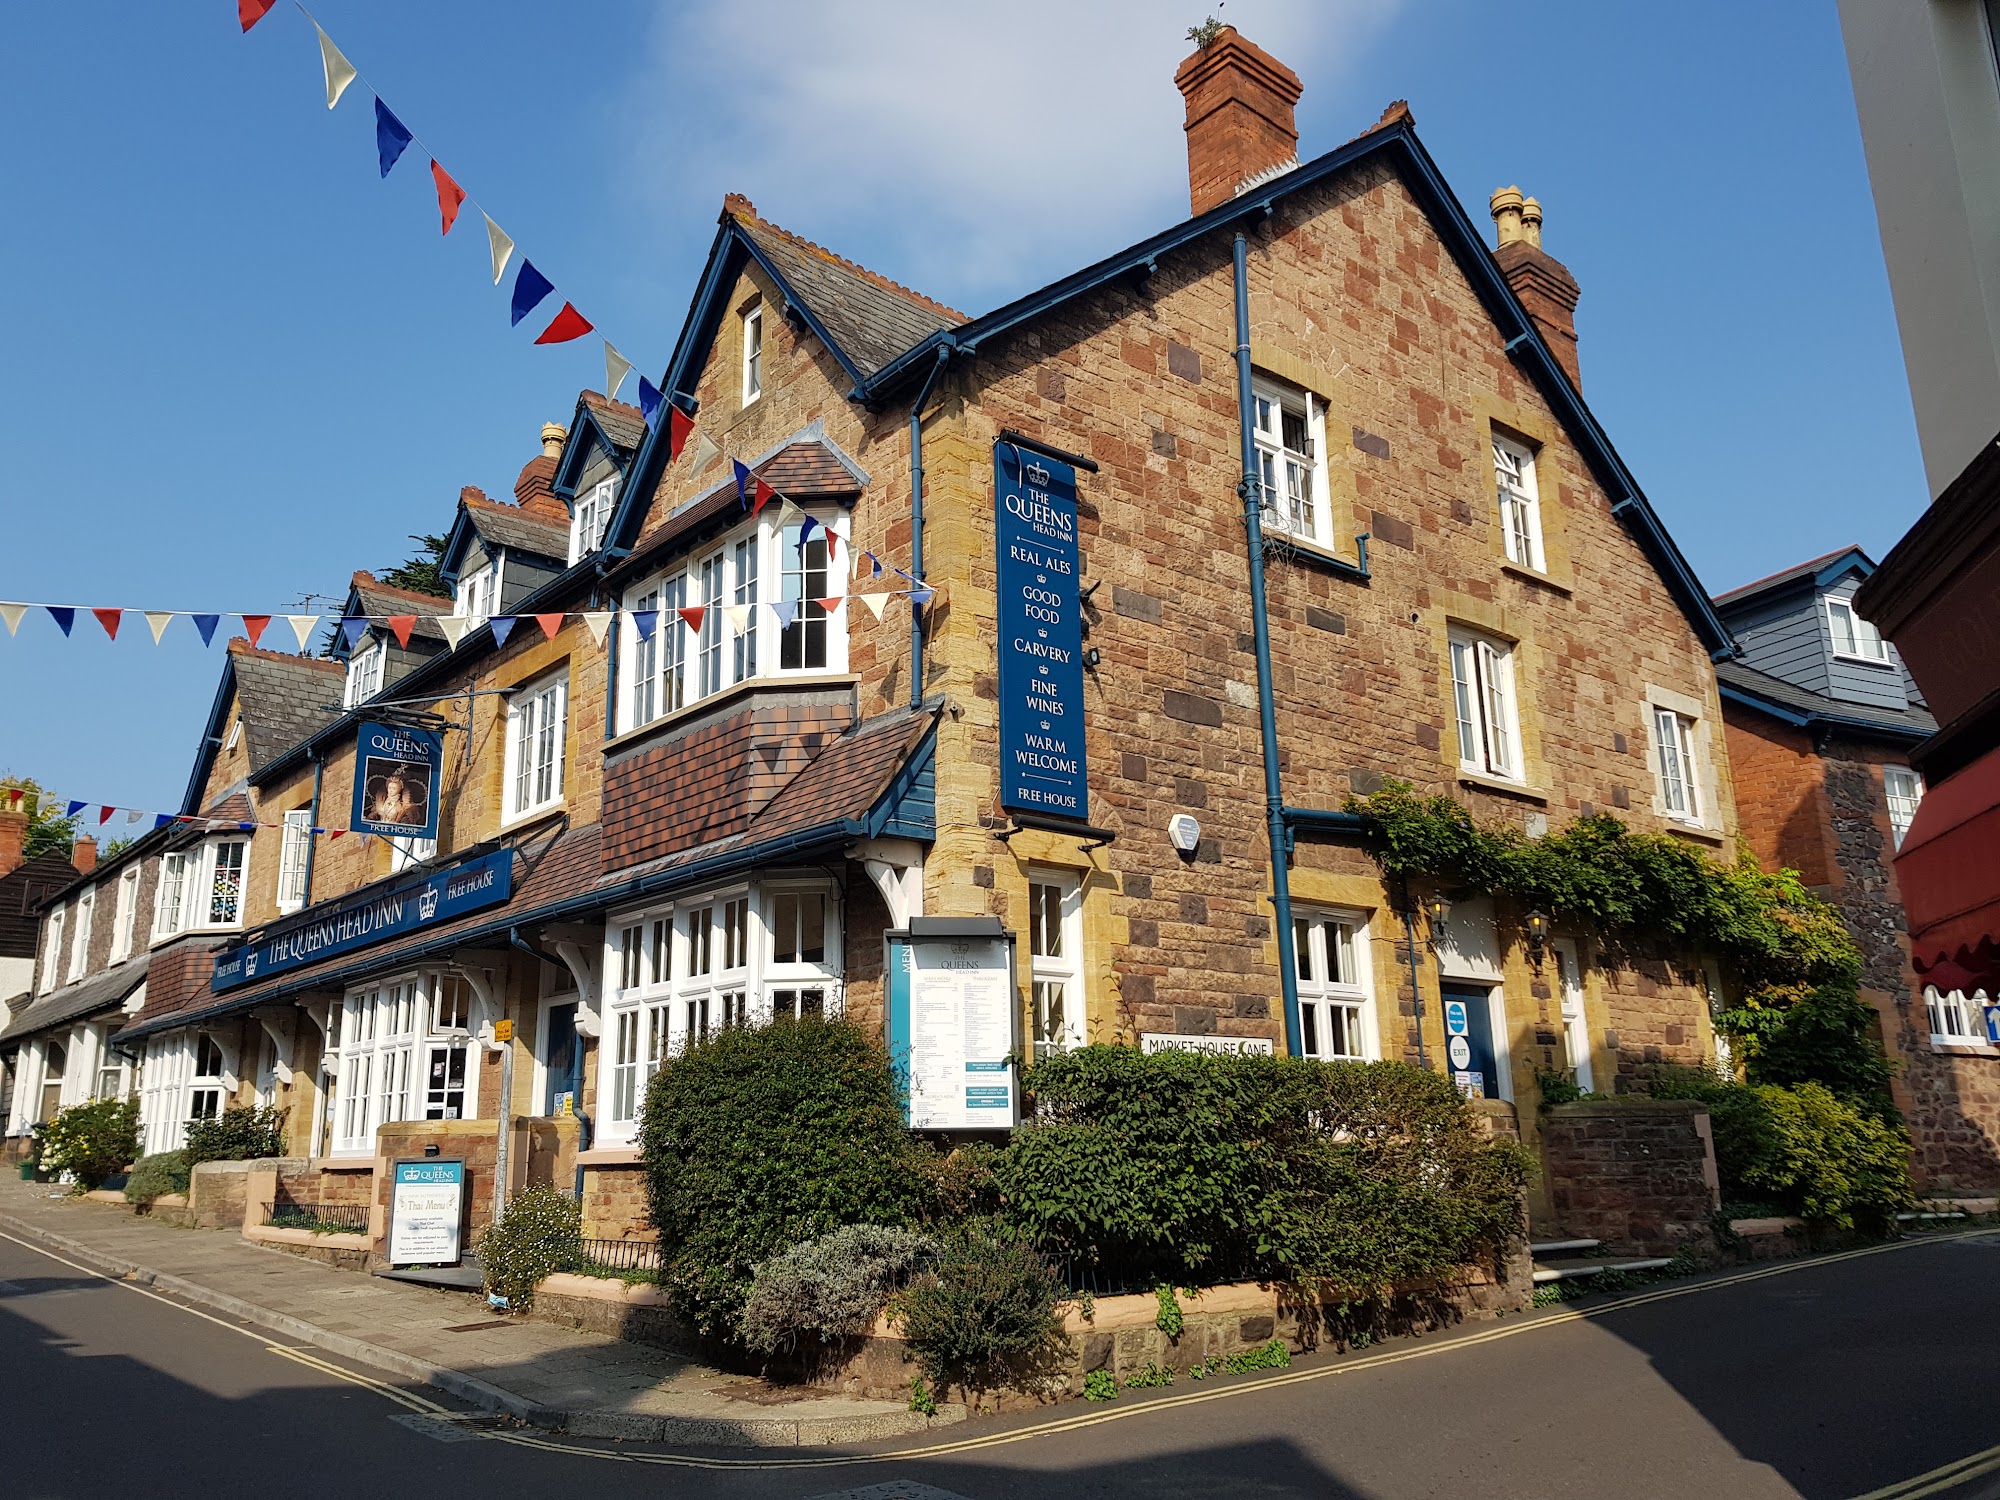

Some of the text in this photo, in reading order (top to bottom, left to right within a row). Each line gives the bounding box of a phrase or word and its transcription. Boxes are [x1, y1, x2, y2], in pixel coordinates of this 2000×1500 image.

[1028, 488, 1050, 506] THE
[1005, 494, 1072, 532] QUEENS
[1033, 522, 1073, 543] HEAD INN
[1010, 545, 1071, 575] REAL ALES
[1022, 585, 1061, 607] GOOD
[1025, 604, 1060, 625] FOOD
[1014, 638, 1071, 664] CARVERY
[1031, 679, 1057, 697] FINE
[1026, 696, 1064, 716] WINES
[393, 729, 411, 739] THE
[1024, 733, 1066, 754] WARM
[371, 735, 429, 755] QUEENS
[393, 751, 429, 762] HEAD INN
[1015, 749, 1078, 774] WELCOME
[1018, 787, 1076, 808] FREE HOUSE
[370, 823, 418, 835] FREE HOUSE
[448, 870, 494, 900] FREE HOUSE
[269, 893, 404, 964] THE QUEENS HEAD INN
[940, 960, 979, 972] QUEENS
[1149, 1039, 1267, 1056] MARKET HOUSE ANE
[421, 1171, 454, 1180] QUEENS
[407, 1199, 446, 1211] Thai Menu
